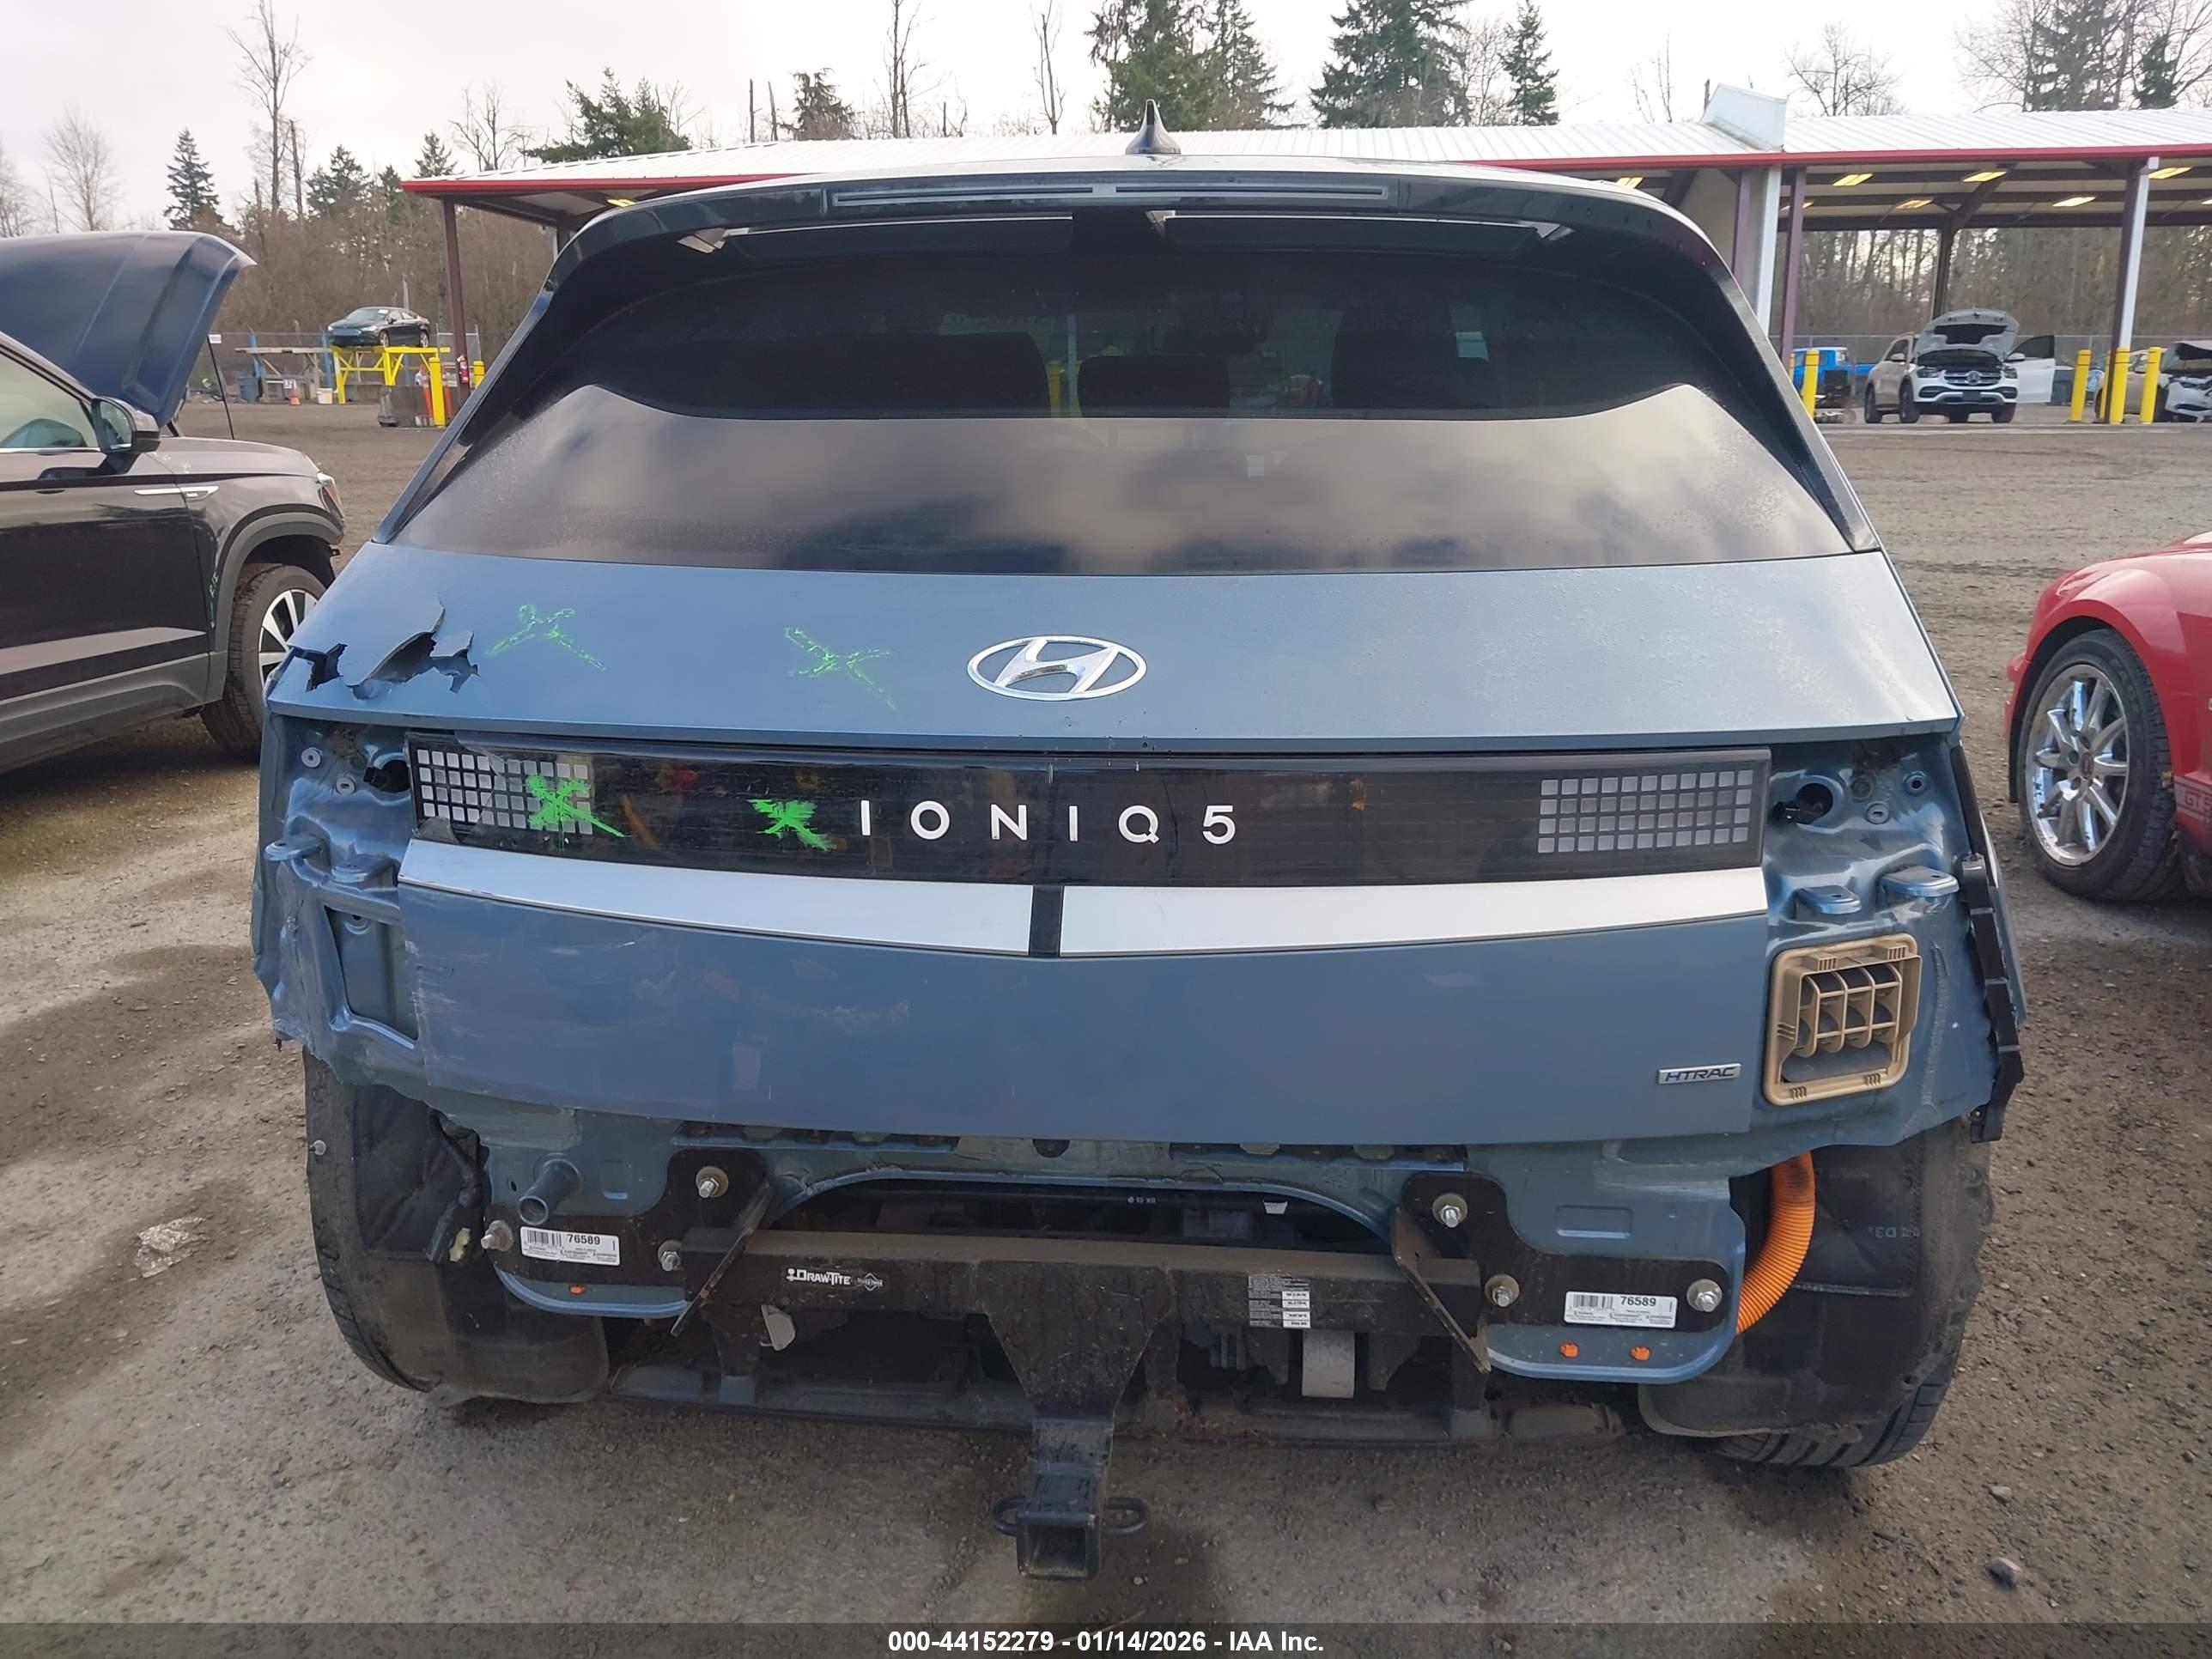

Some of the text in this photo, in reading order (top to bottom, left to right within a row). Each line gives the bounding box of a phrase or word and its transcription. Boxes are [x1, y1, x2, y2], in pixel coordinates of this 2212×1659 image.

[860, 799, 1236, 845] IONIQ 5
[1665, 1066, 1736, 1082] HTRAC
[568, 1233, 600, 1245] 76589
[1620, 1295, 1656, 1307] 76589
